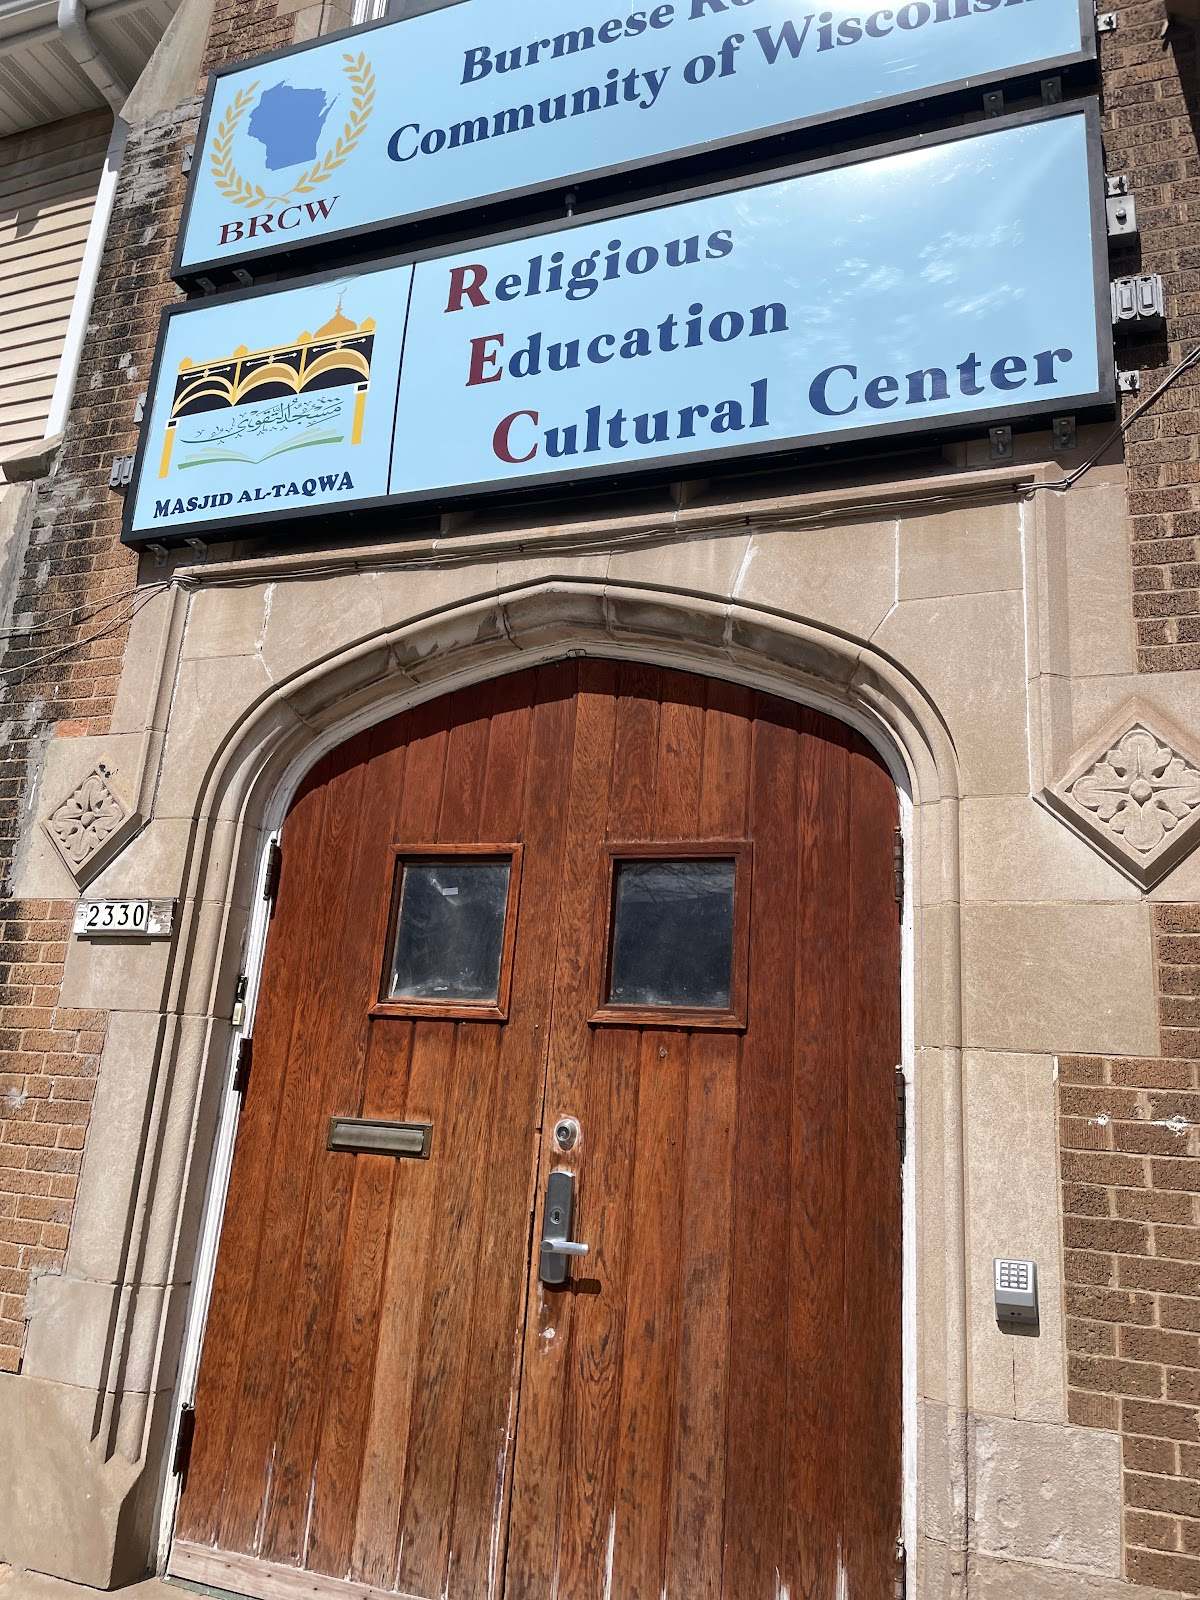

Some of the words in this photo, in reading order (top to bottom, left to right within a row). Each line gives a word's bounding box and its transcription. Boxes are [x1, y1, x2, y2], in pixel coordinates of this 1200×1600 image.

[460, 4, 675, 85] Burmese
[387, 65, 672, 162] Community
[683, 33, 745, 85] of
[217, 195, 340, 246] BRCW
[444, 229, 734, 314] Religious
[465, 302, 790, 387] Education
[492, 377, 770, 464] Cultural
[808, 348, 1074, 416] Center
[153, 492, 234, 519] MASJID
[236, 471, 355, 504] AL-TAQWA
[86, 904, 144, 927] 2330
